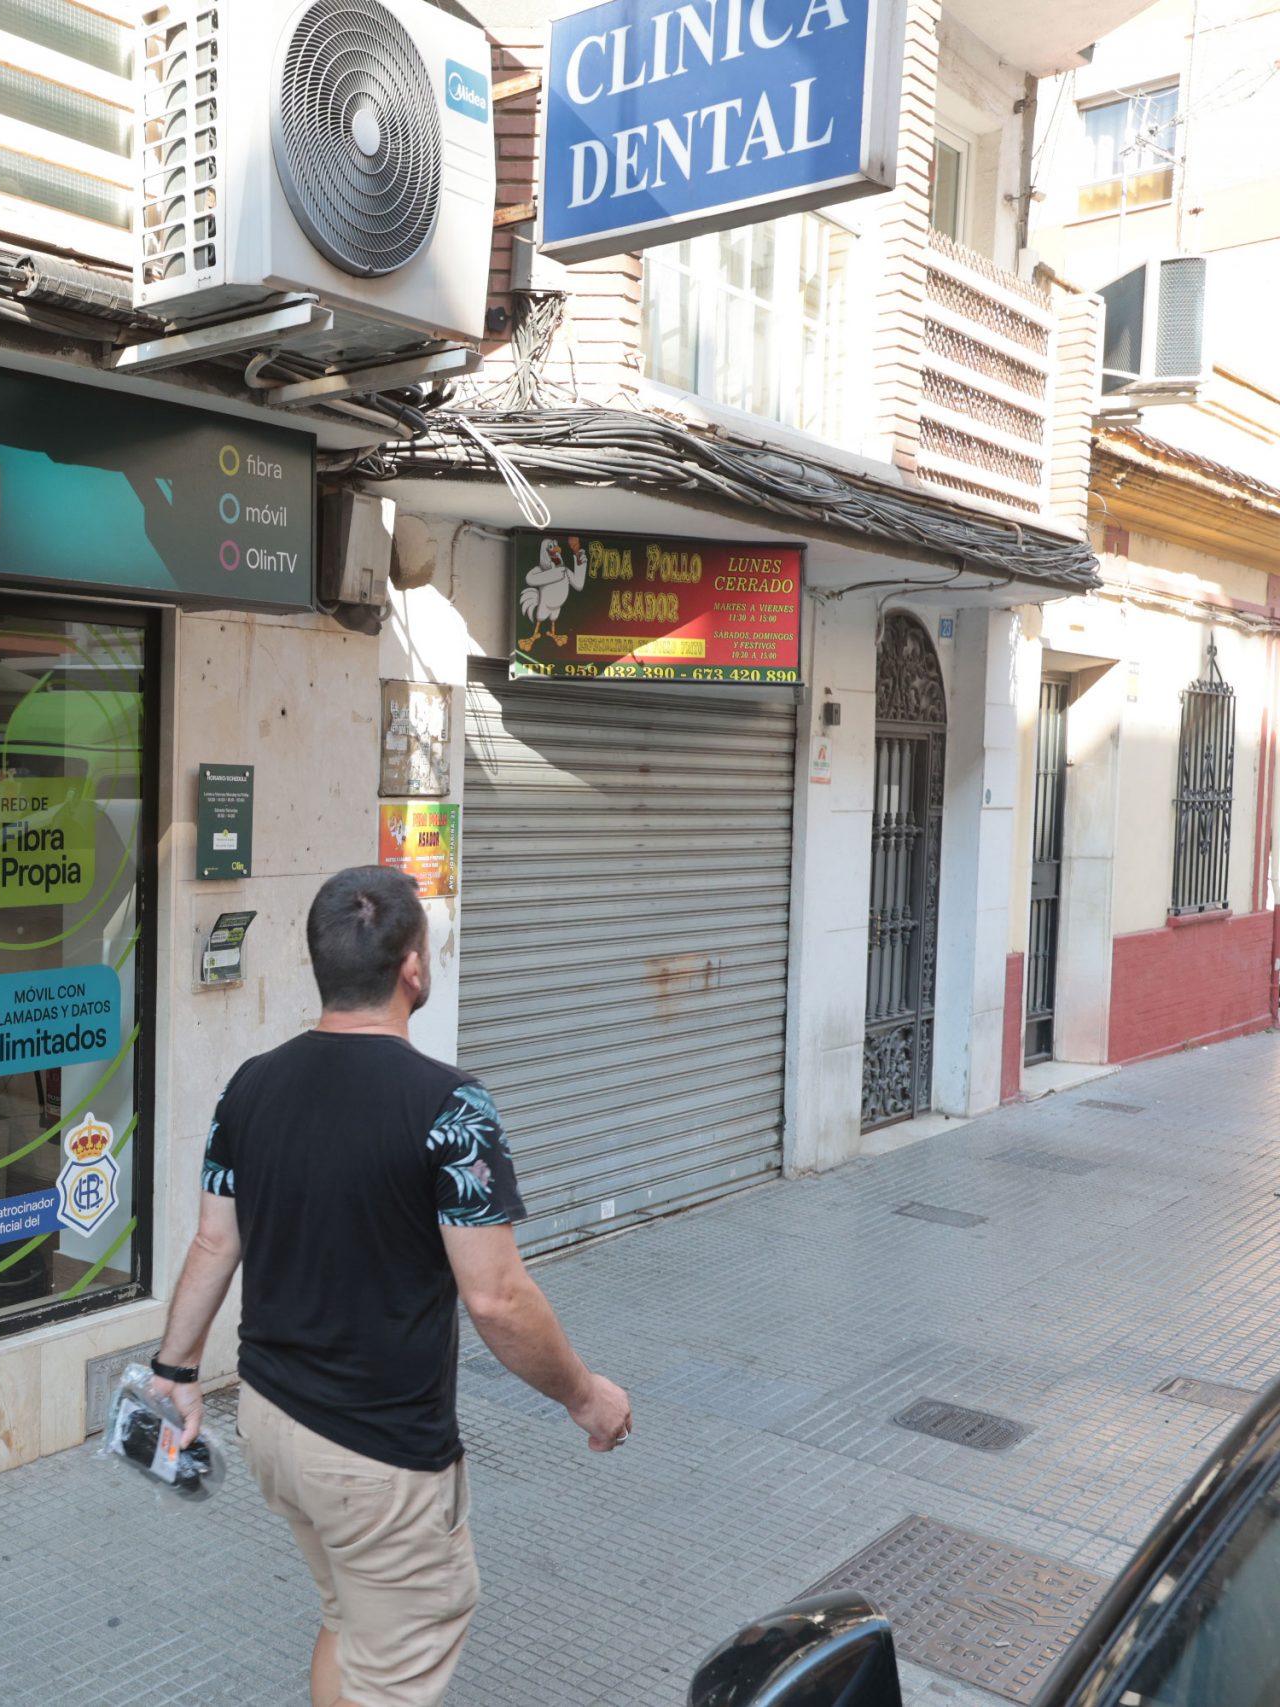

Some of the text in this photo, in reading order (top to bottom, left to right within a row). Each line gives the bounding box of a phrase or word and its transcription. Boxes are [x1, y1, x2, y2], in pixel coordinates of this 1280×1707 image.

[565, 0, 849, 106] CLINICA
[448, 70, 486, 110] Midea
[567, 77, 833, 209] DENTAL
[246, 454, 283, 479] fibra
[246, 503, 287, 527] móvil
[246, 549, 297, 574] OlinTV
[588, 541, 703, 584] PIDA POLLO
[728, 557, 782, 574] LUNES
[714, 576, 794, 594] CERRADO
[608, 590, 679, 623] ASADOR
[713, 602, 794, 613] MARTES A VIERNES
[740, 642, 777, 650] FESTIVOS
[753, 632, 794, 641] DOMINGOS
[565, 664, 598, 677] 959
[604, 665, 637, 678] 032
[643, 666, 675, 679] 390
[693, 667, 724, 680] 673
[730, 668, 761, 681] 420
[766, 669, 797, 682] 890
[1, 797, 49, 813] RED DE
[1, 820, 64, 852] Fibra
[418, 831, 440, 848] ASADOR
[1, 854, 81, 893] Propia
[14, 983, 86, 1005] MÓVIL CON
[59, 1004, 70, 1019] Y
[70, 999, 111, 1018] DATOS
[24, 1214, 40, 1229] del
